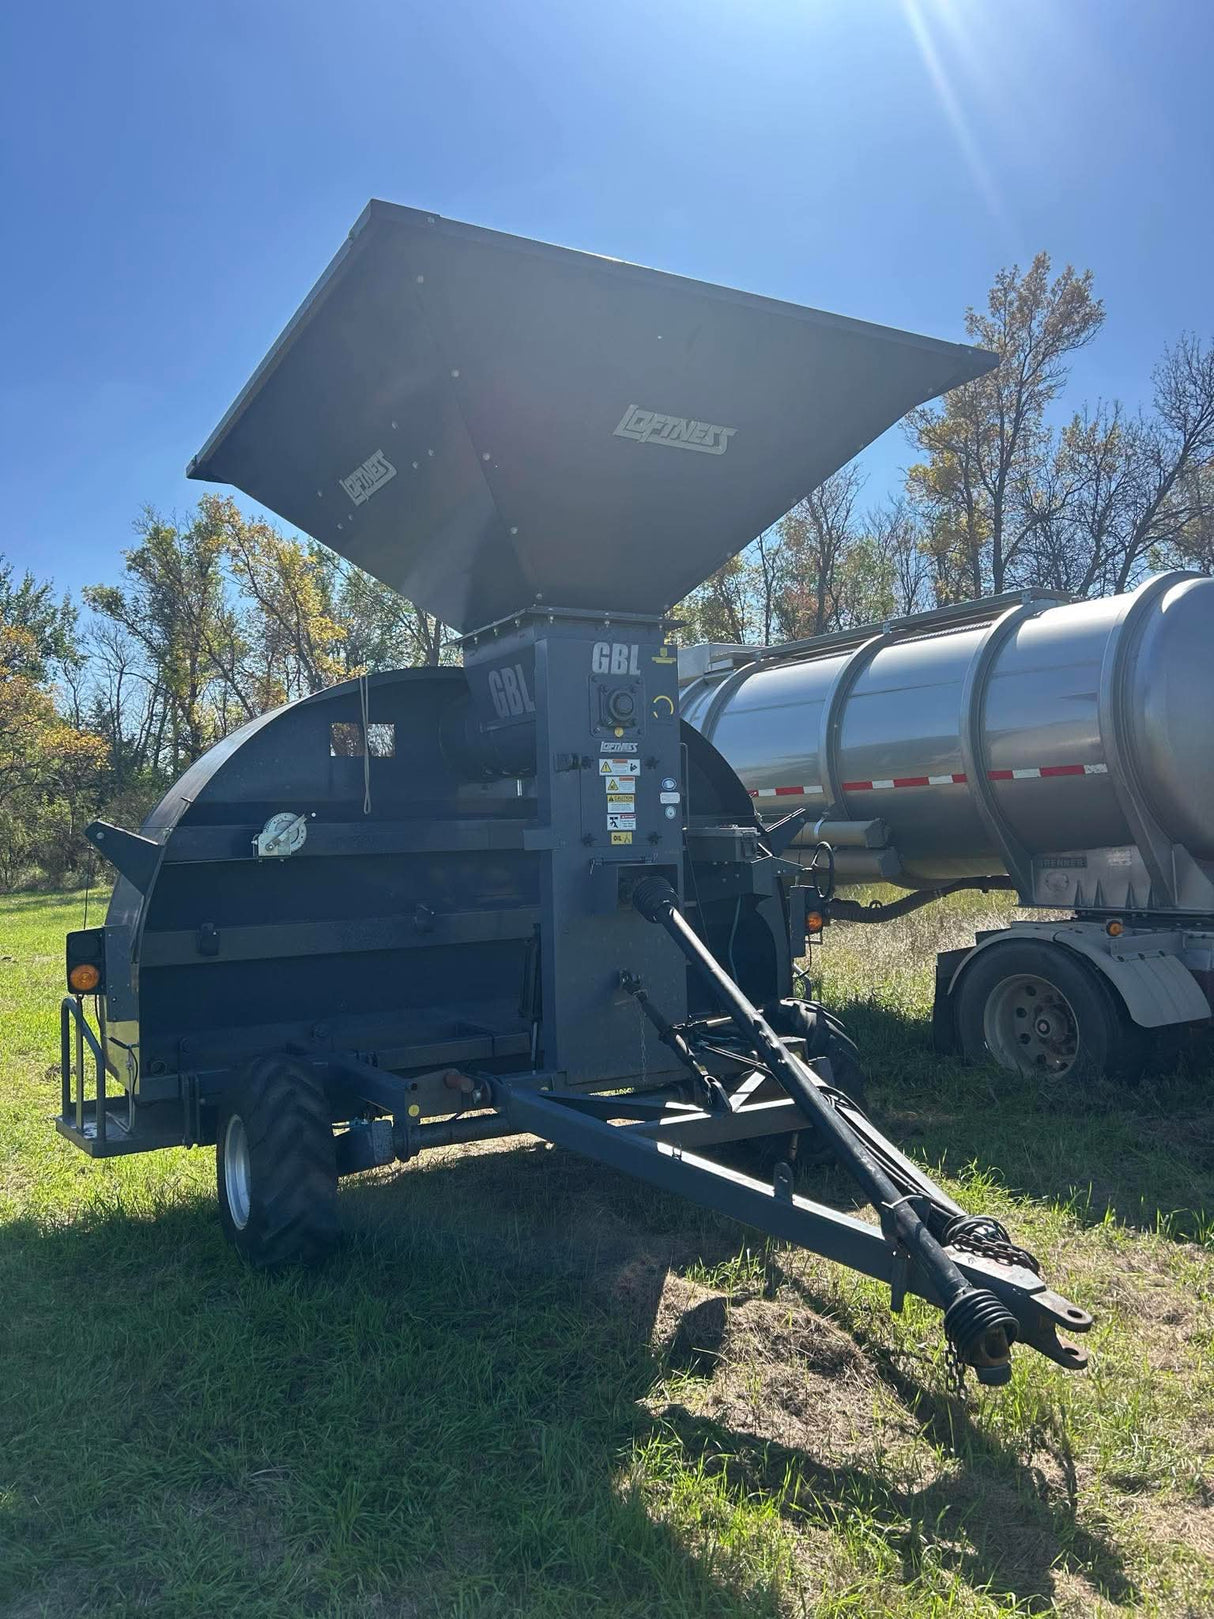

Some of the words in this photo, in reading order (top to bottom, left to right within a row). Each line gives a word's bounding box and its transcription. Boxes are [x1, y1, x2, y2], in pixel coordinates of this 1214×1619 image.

[612, 404, 738, 455] LOFTNESS
[339, 449, 397, 506] LOFTNESS
[592, 642, 641, 675] GBL
[488, 664, 536, 719] GBL
